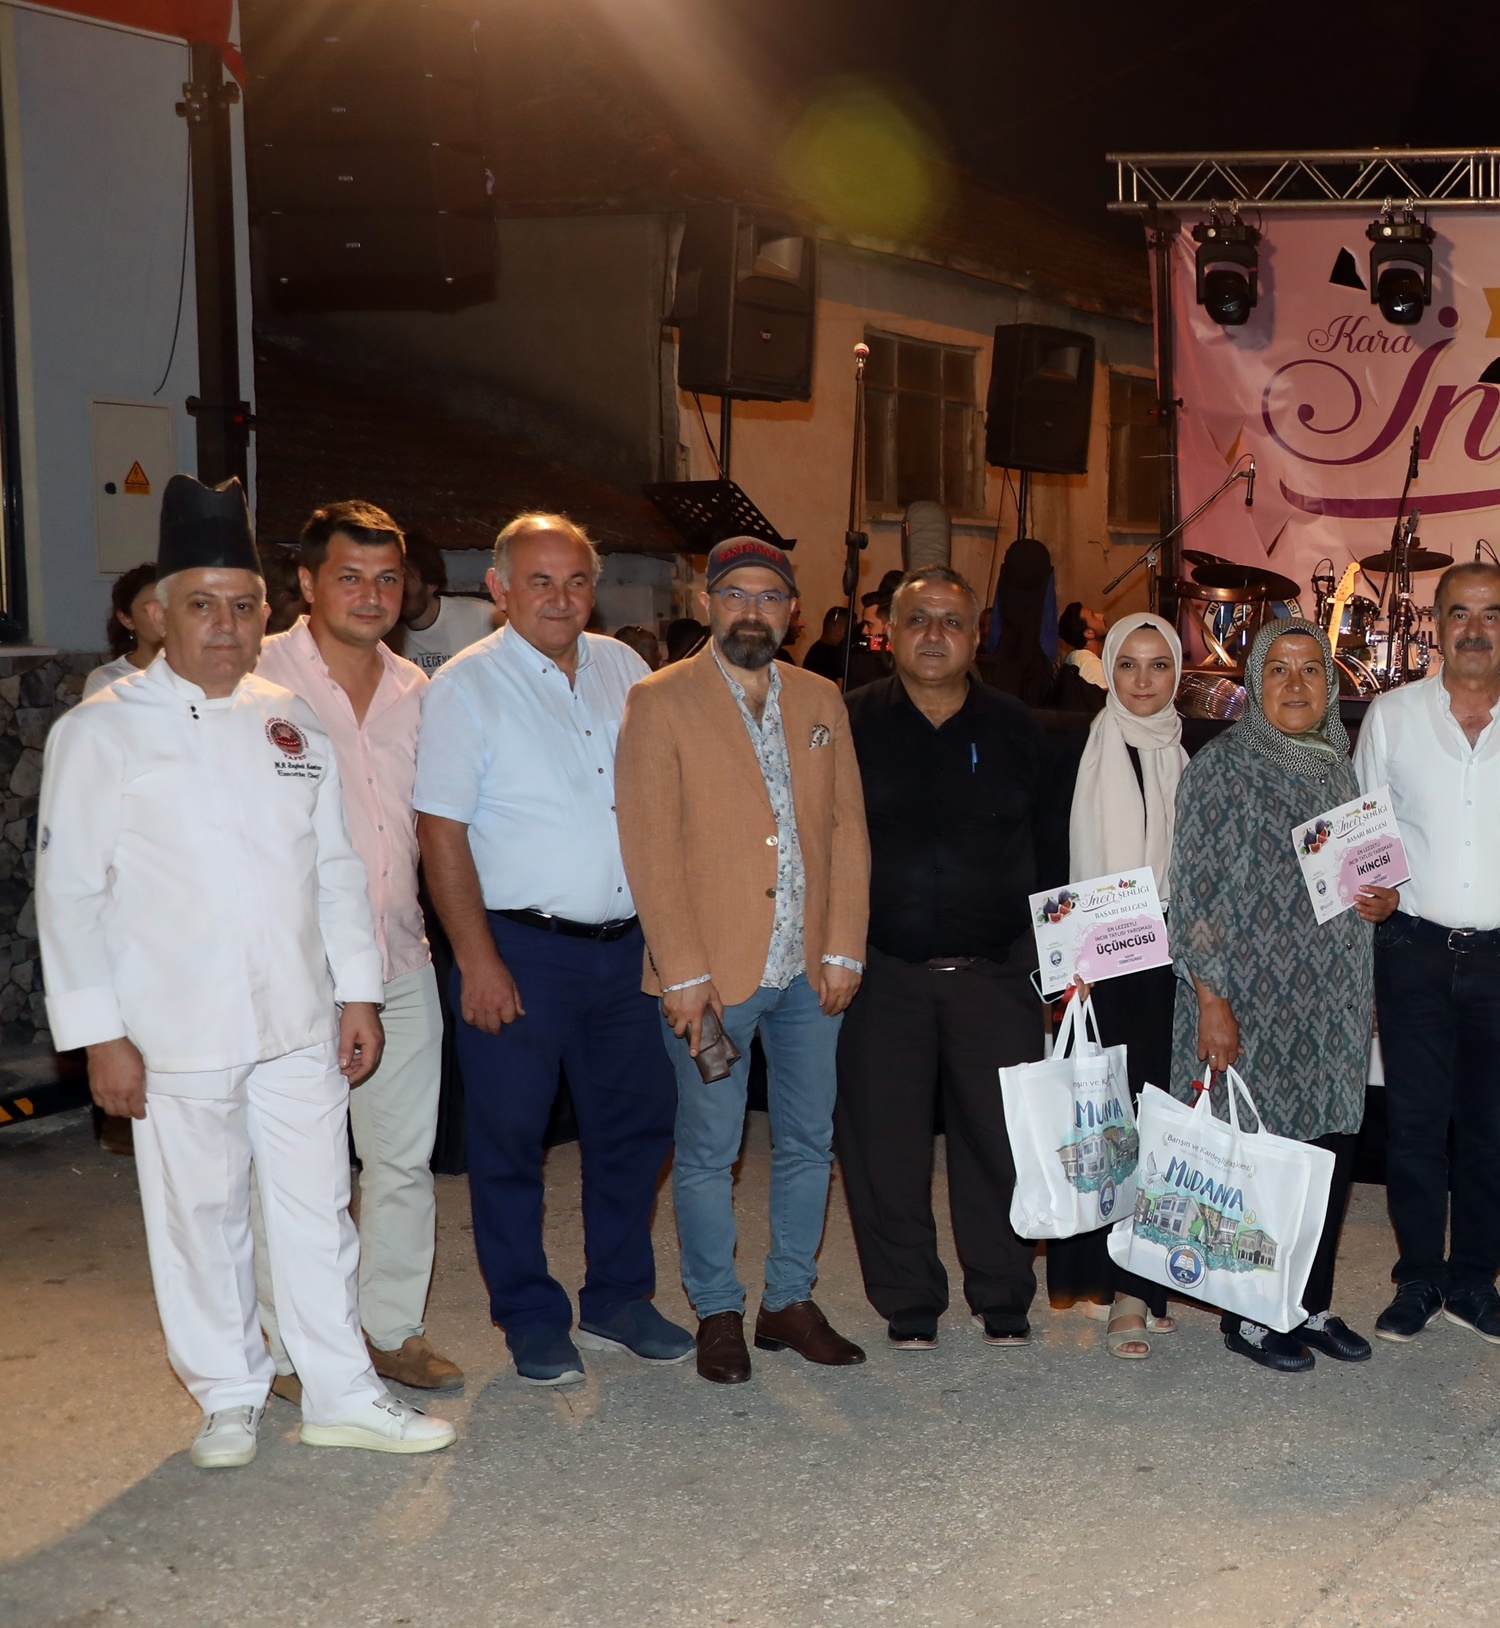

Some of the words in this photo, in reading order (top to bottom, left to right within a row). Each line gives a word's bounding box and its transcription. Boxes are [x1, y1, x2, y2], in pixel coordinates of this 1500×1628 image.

[1308, 315, 1414, 353] Kara
[1357, 852, 1391, 876] İKİNCİSİ
[1118, 885, 1149, 899] ŞENLİĞİ
[1095, 907, 1119, 919] BAŞARI
[1121, 902, 1148, 913] BELGESİ
[1096, 932, 1156, 955] ÜÇÜNCÜSÜ
[1168, 1134, 1190, 1148] Barışın
[1192, 1143, 1199, 1151] ve
[1229, 1161, 1252, 1172] aşkenti
